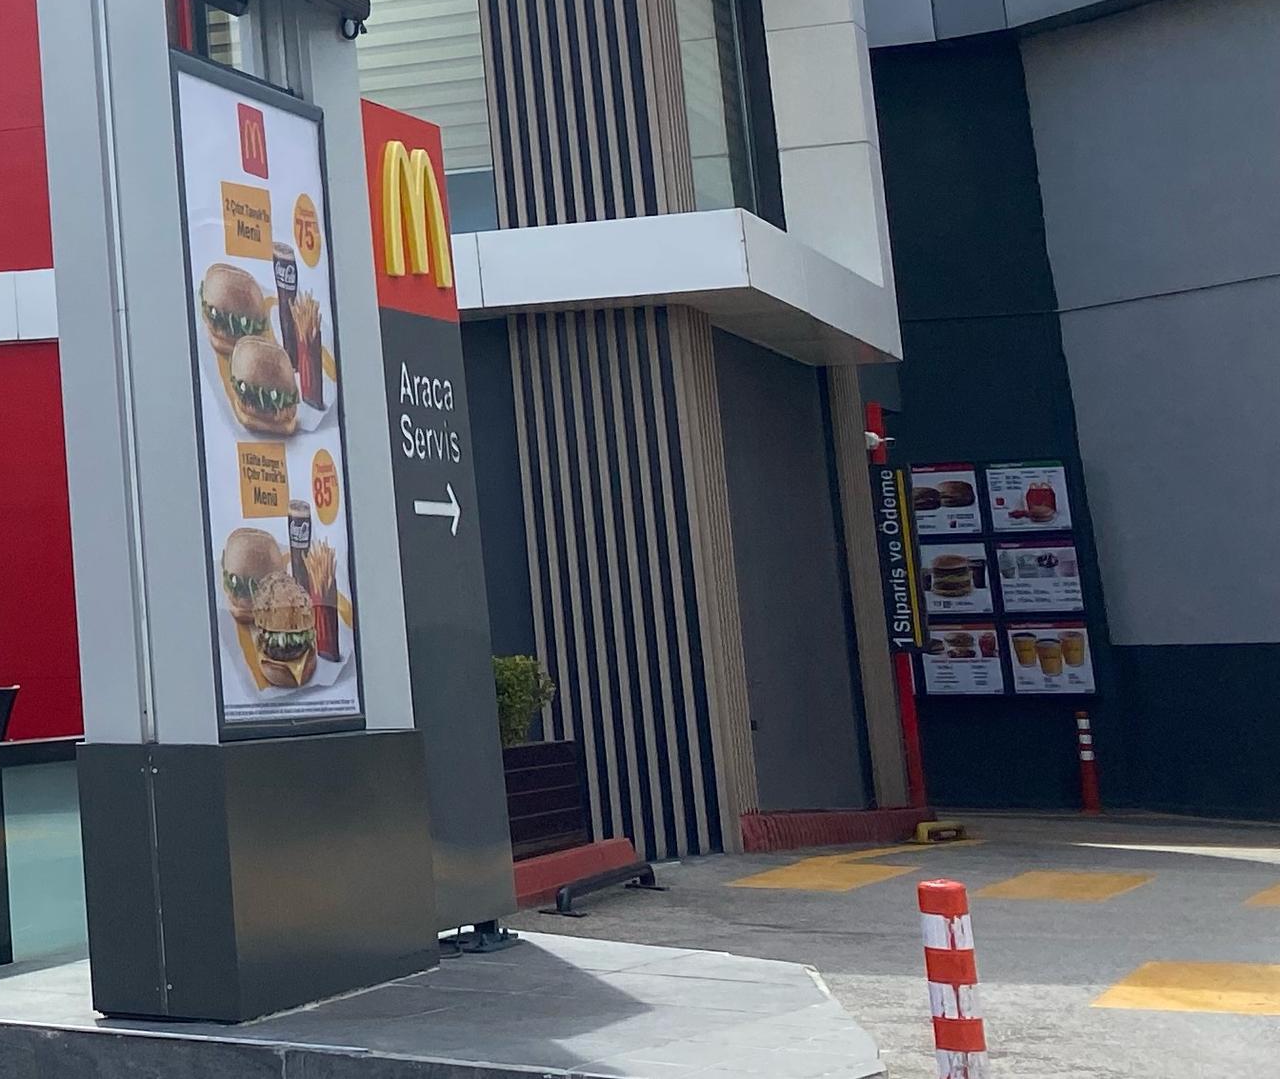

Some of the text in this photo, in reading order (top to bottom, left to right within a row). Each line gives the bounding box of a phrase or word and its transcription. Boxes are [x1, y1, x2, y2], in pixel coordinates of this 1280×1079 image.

[237, 219, 261, 242] Menü
[296, 218, 315, 251] 75
[400, 361, 454, 412] Araca
[400, 413, 461, 463] Servis
[253, 486, 278, 507] Menü
[314, 476, 332, 508] 85
[879, 469, 900, 535] Ödeme
[889, 541, 902, 562] ve
